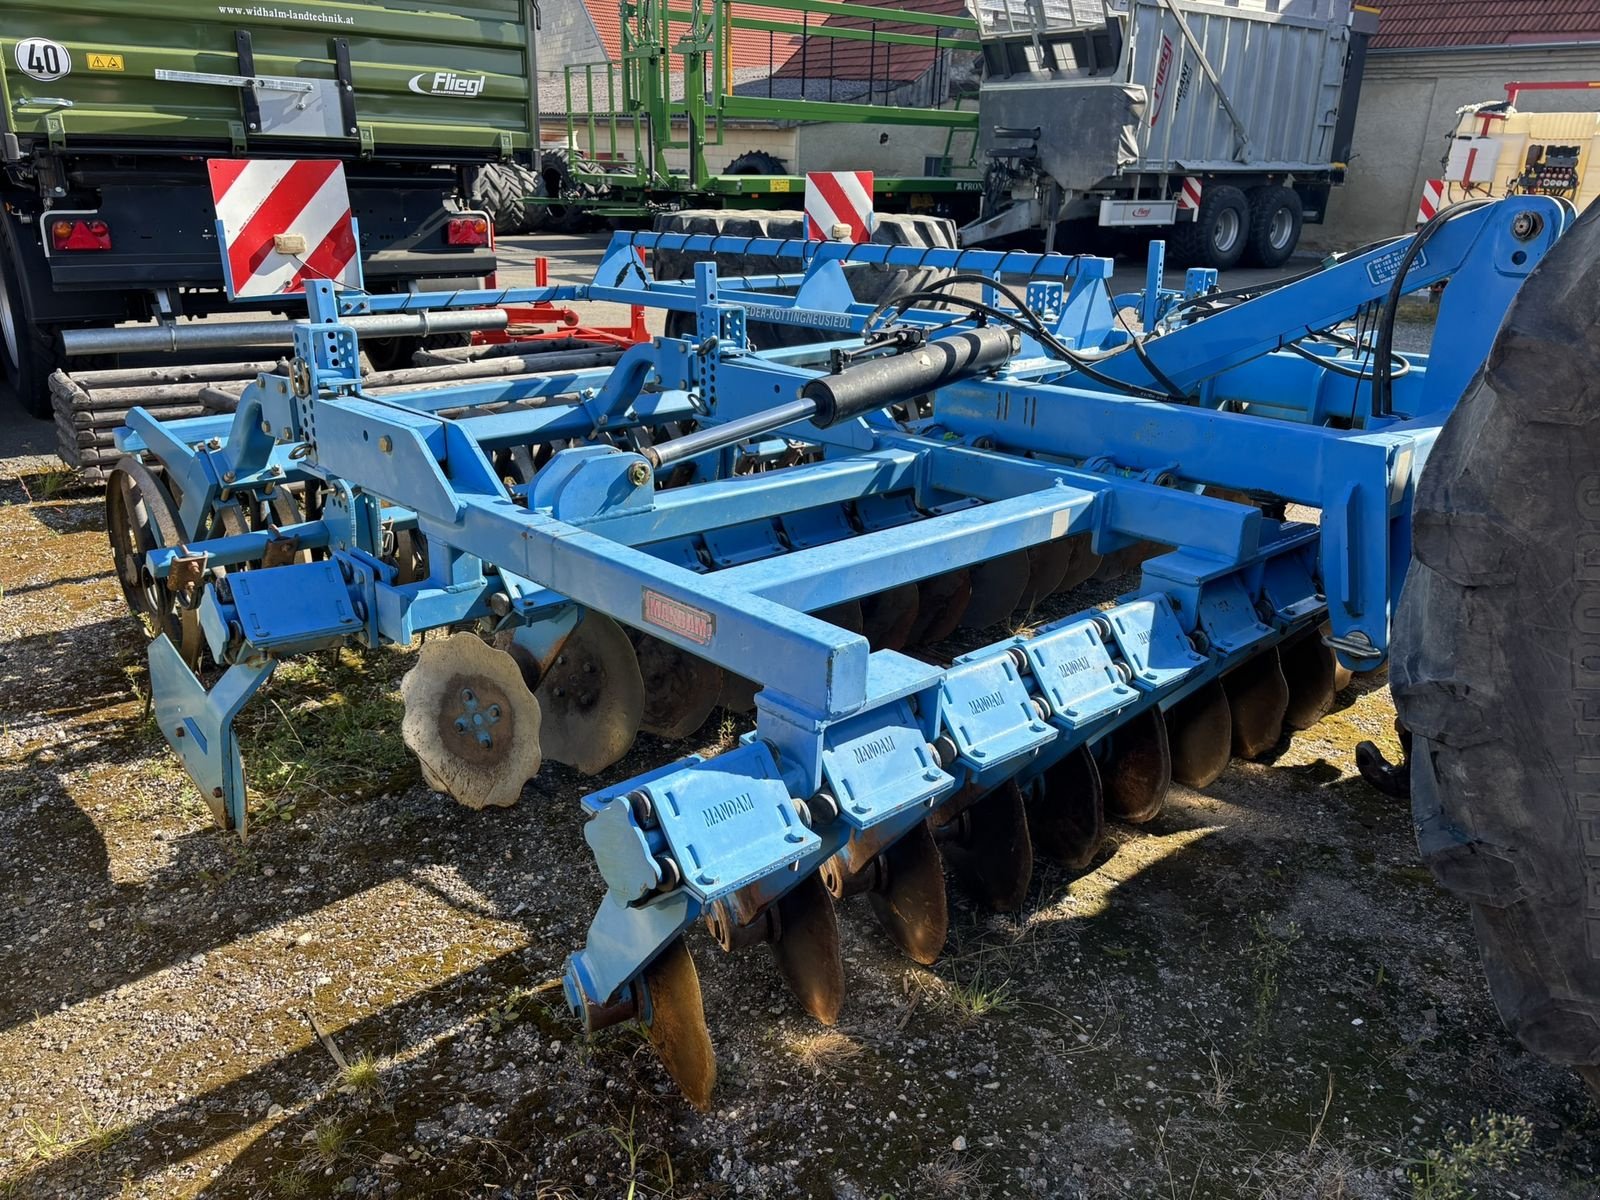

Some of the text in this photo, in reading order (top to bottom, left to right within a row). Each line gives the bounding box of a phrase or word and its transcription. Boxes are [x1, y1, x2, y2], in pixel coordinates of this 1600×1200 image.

[219, 6, 354, 25] www.widhalm-landtechnik.at
[28, 44, 60, 74] 40
[432, 72, 485, 96] Fliegl
[649, 596, 707, 640] MANDAM
[1058, 656, 1090, 678] MANDAM
[968, 691, 1005, 715] MANDAM
[853, 736, 896, 764] MANDAM
[702, 793, 754, 827] MANDAM
